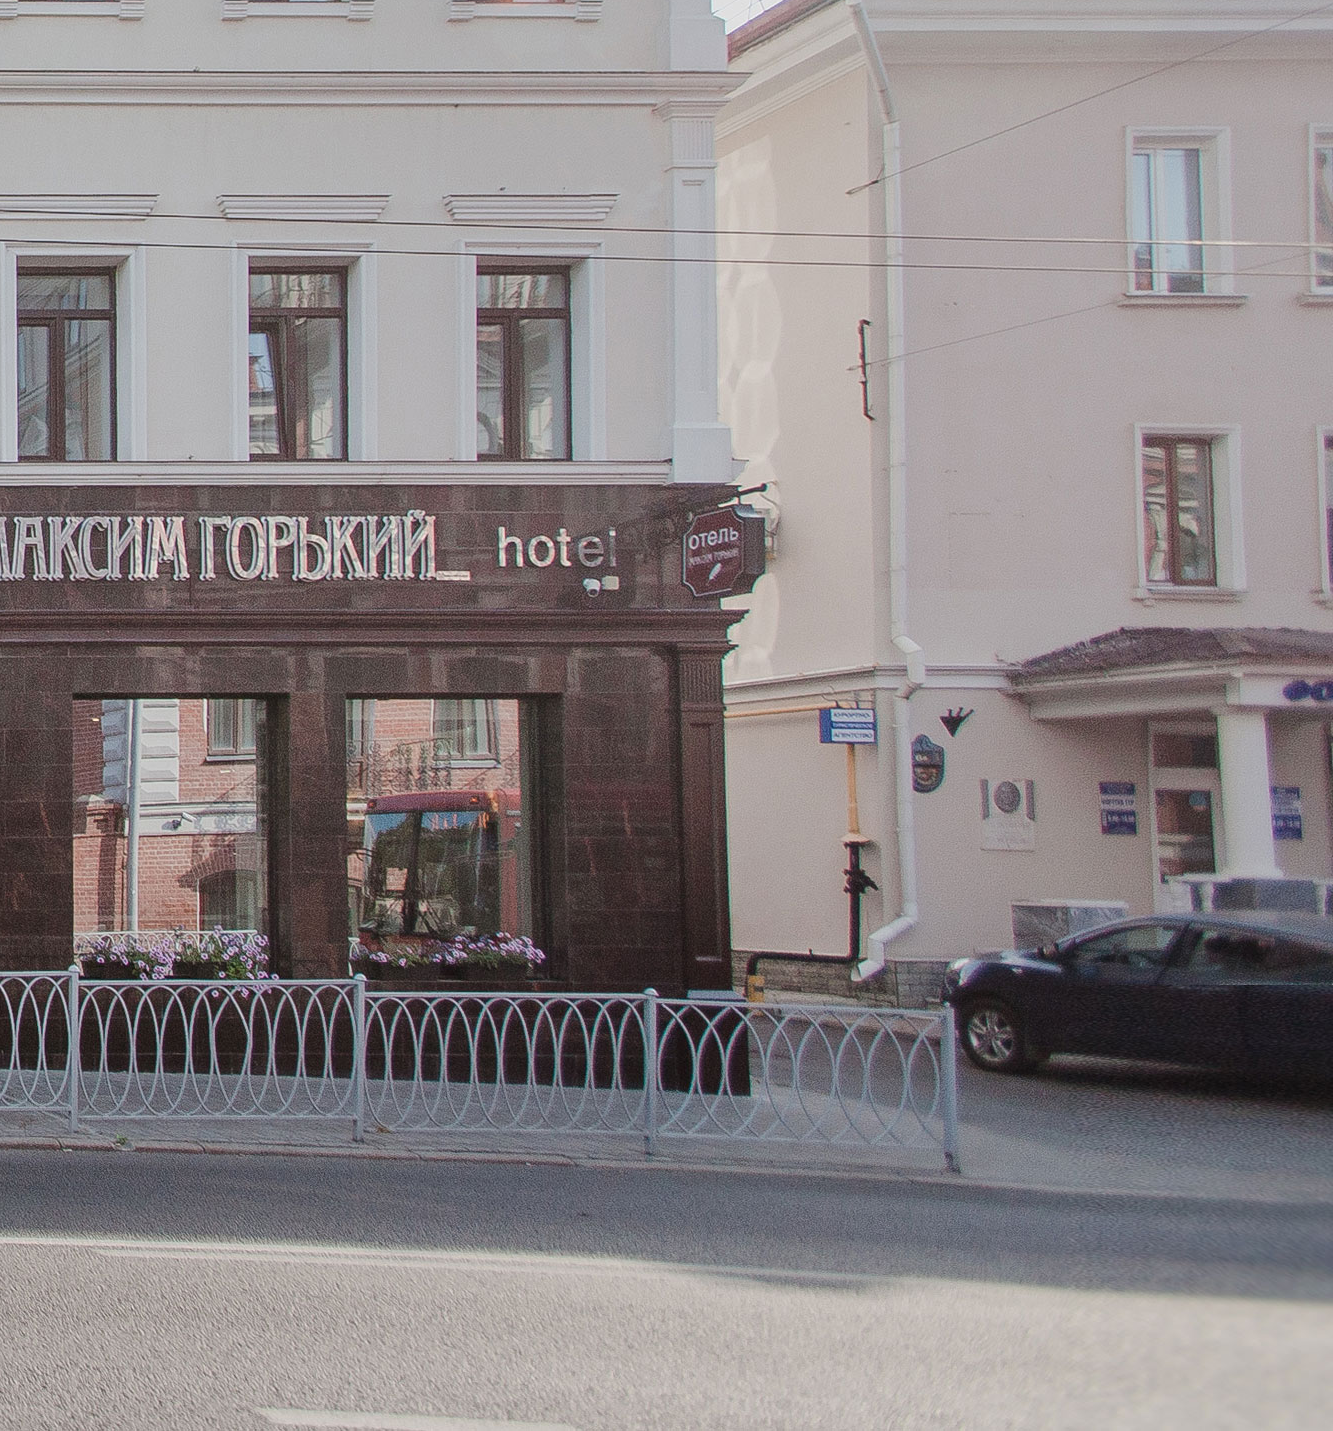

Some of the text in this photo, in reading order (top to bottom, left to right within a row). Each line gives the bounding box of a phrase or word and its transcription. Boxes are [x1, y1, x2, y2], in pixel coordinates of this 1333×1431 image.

[199, 509, 436, 582] ГОРЬКИЙ
[497, 526, 617, 568] hotel
[688, 527, 739, 550] отель
